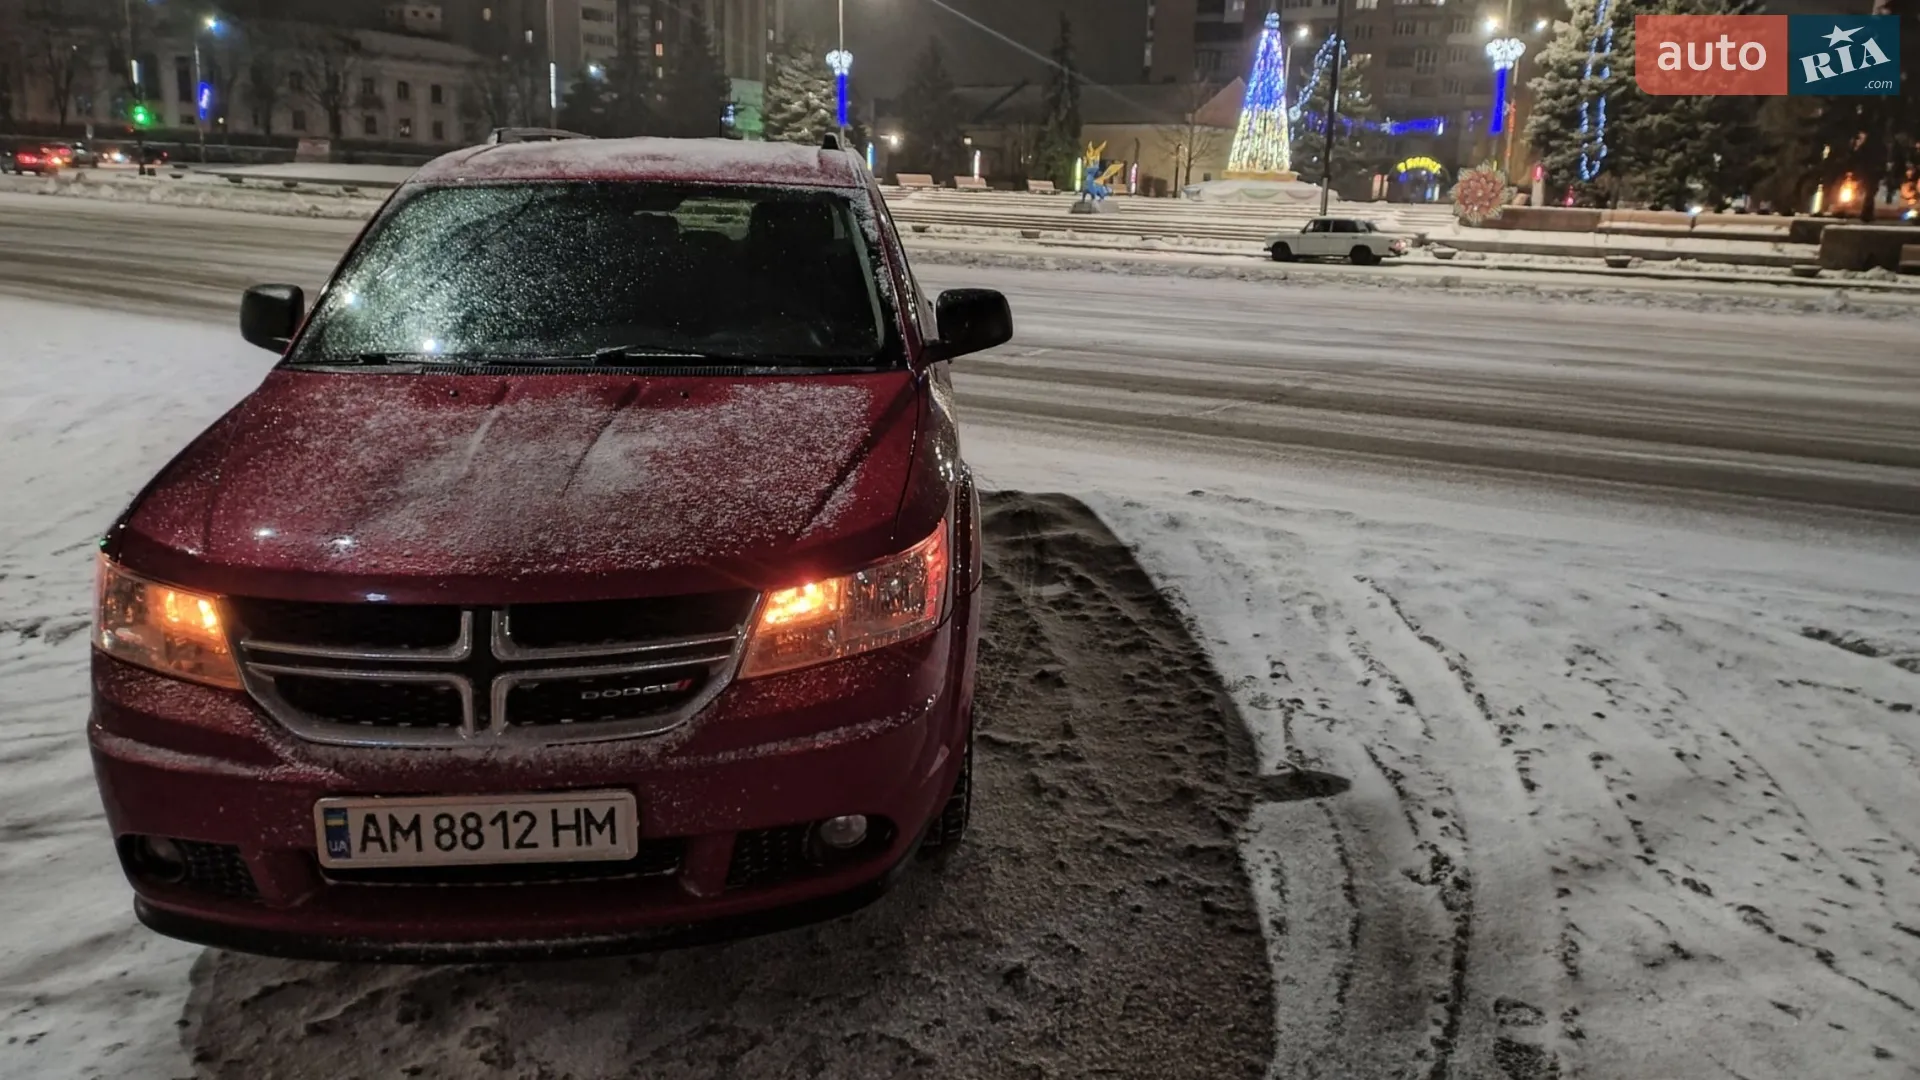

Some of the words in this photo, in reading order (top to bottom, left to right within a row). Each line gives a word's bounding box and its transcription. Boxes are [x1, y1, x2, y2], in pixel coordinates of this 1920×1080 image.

[581, 682, 678, 700] DODGE
[359, 813, 423, 853] AM
[433, 810, 539, 850] 8812
[551, 806, 617, 847] HM
[329, 840, 347, 852] UA
